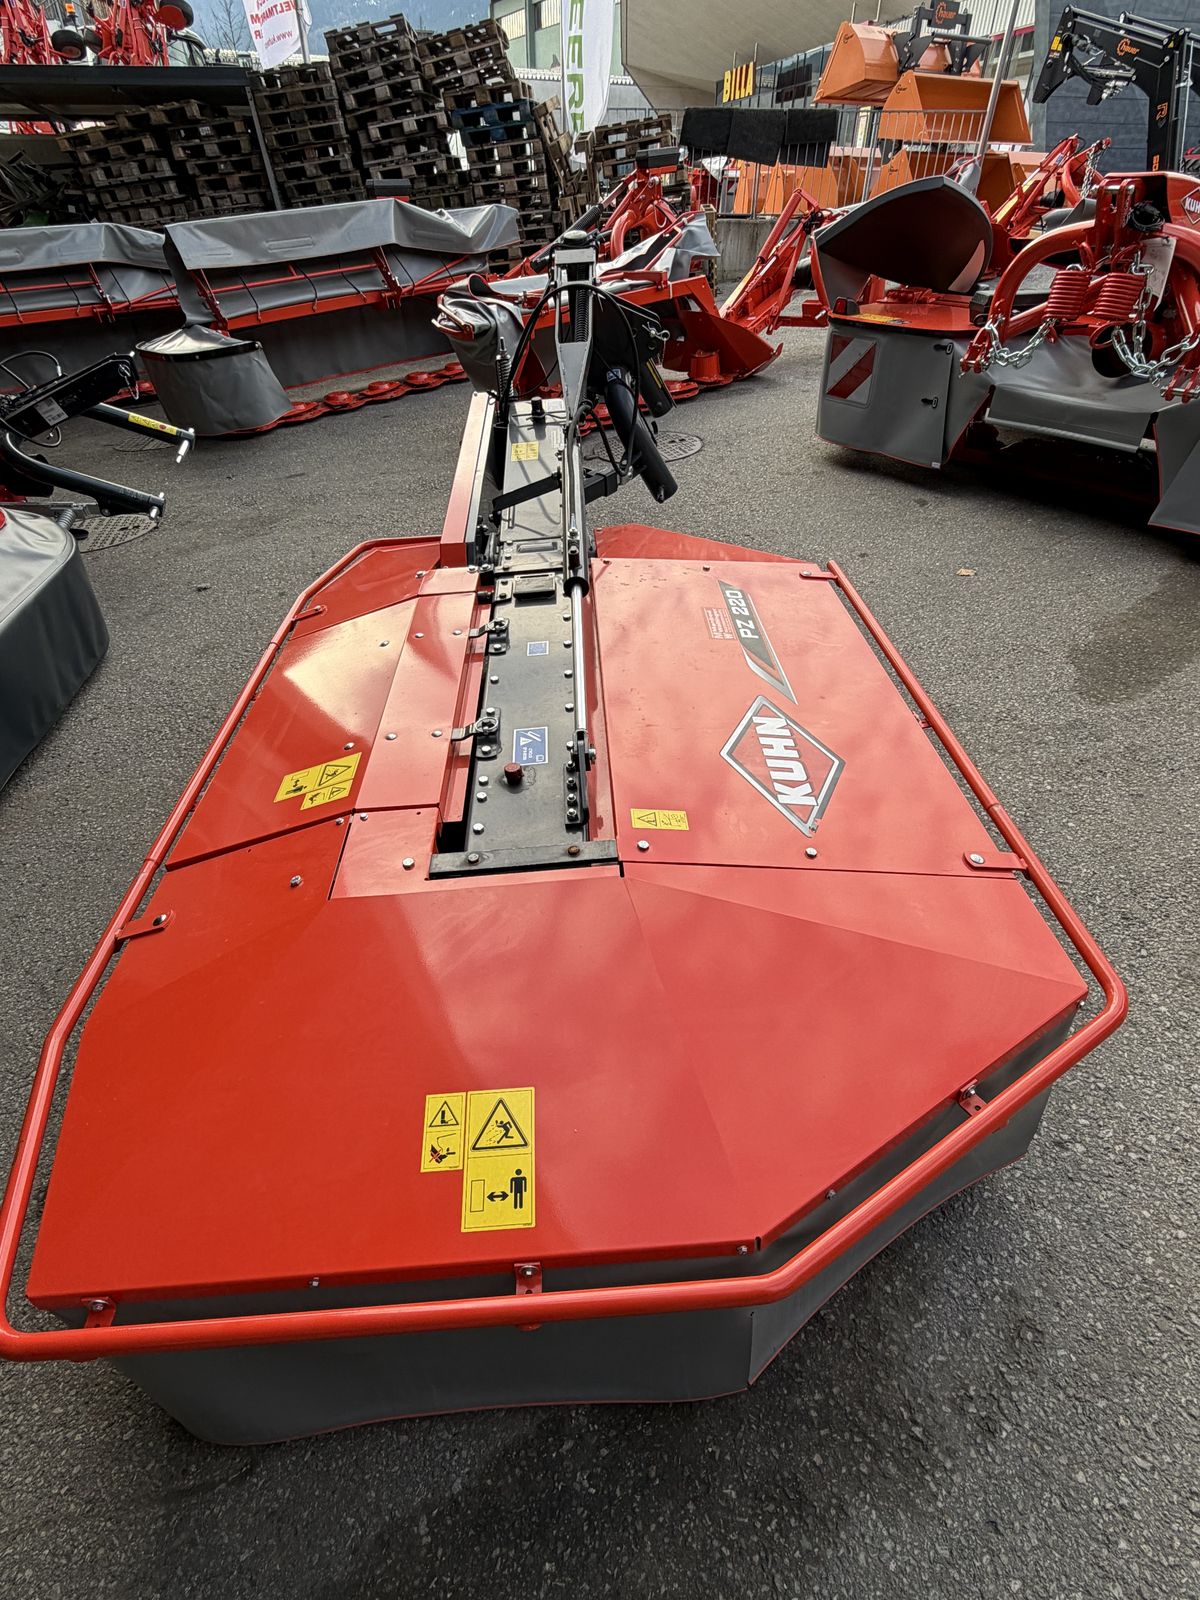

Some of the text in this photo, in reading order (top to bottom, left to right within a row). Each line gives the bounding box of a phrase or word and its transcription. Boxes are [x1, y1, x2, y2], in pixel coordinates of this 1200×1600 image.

[722, 61, 754, 104] BILLA
[725, 590, 759, 639] PZ 220
[751, 716, 818, 806] KUHN
